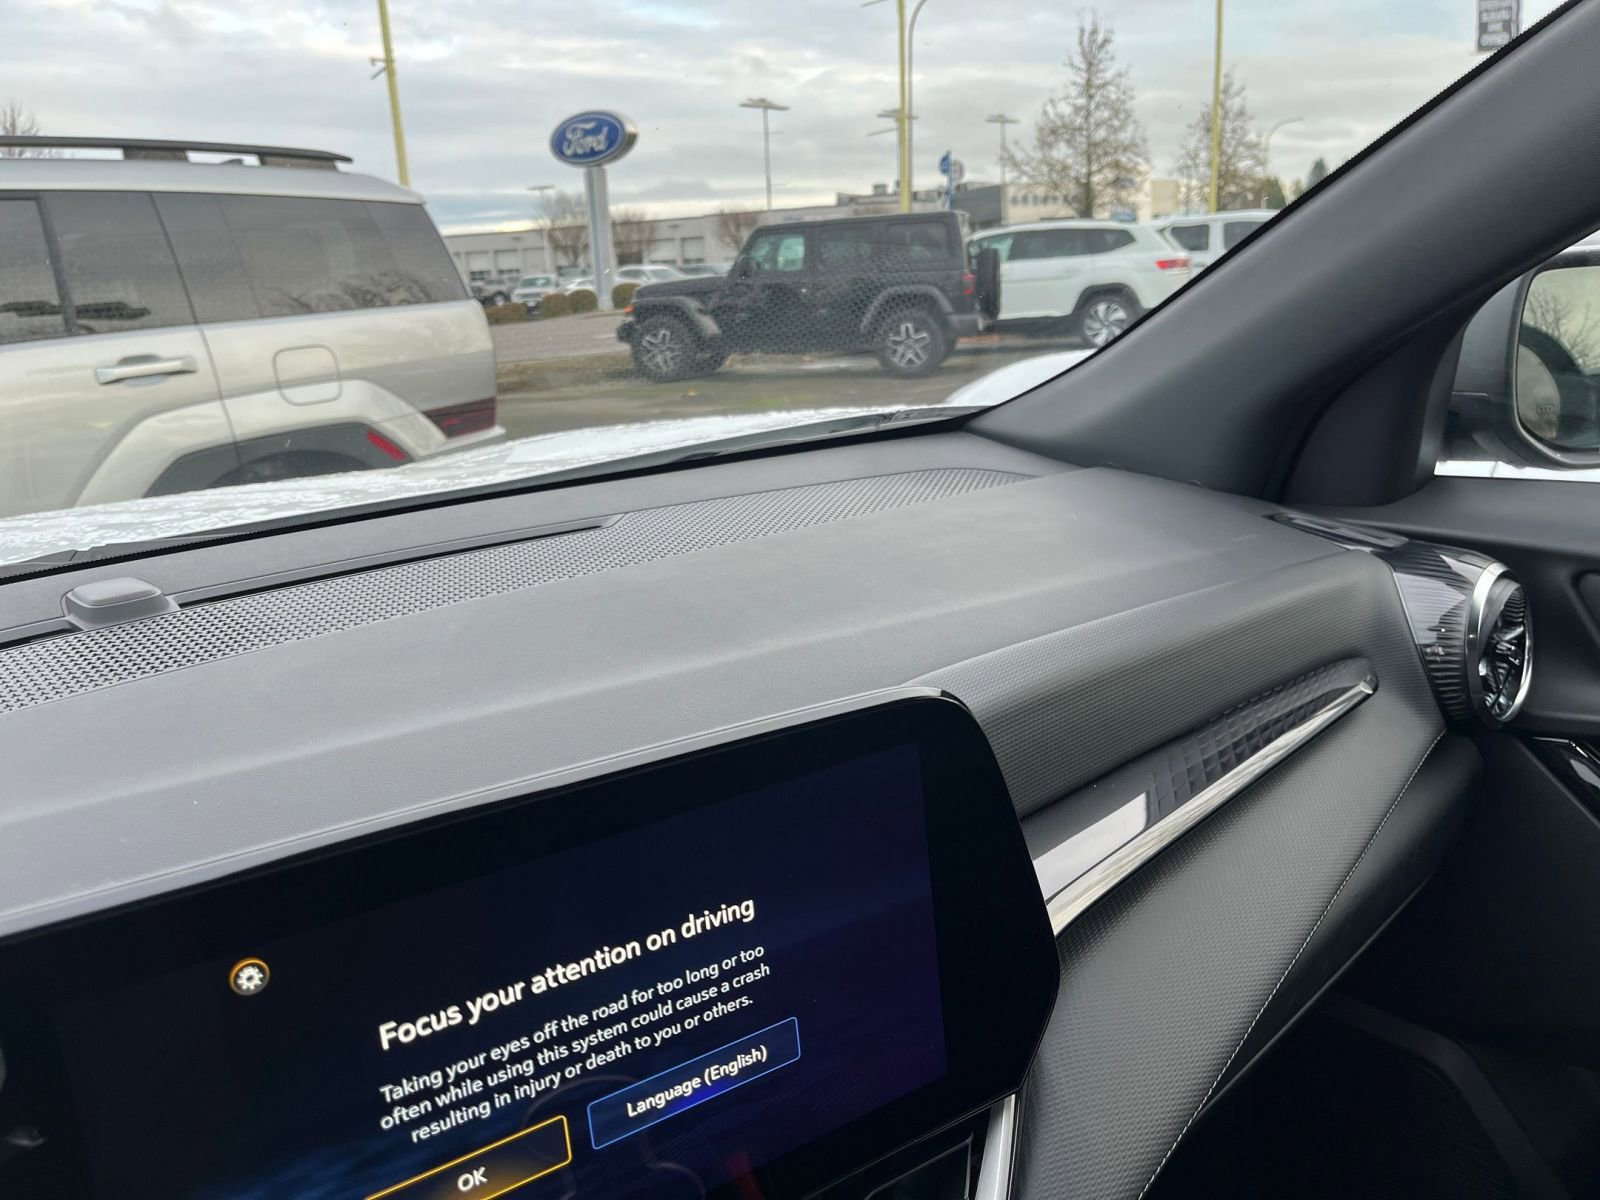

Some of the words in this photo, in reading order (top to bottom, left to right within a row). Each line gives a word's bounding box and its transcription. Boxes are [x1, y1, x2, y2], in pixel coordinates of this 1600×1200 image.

[562, 121, 609, 156] Ford
[379, 1005, 463, 1050] Focus
[466, 981, 526, 1025] your
[531, 941, 641, 994] attention
[646, 928, 676, 951] on
[681, 900, 755, 938] driving
[379, 1070, 443, 1103] Taking
[445, 1052, 487, 1082] your
[490, 1036, 530, 1061] eyes
[533, 1023, 559, 1044] off
[560, 1014, 589, 1032] the
[592, 994, 629, 1021] road
[631, 987, 654, 1006] for
[656, 977, 683, 996] too
[685, 963, 719, 985] long
[722, 955, 737, 970] or
[740, 946, 764, 963] too
[380, 1100, 432, 1129] often
[435, 1079, 484, 1107] while
[487, 1059, 534, 1087] using
[536, 1045, 569, 1066] this
[571, 1021, 628, 1053] system
[631, 1000, 673, 1029] could
[675, 986, 718, 1010] cause
[720, 981, 730, 993] a
[732, 963, 770, 988] crash
[411, 1101, 490, 1143] resulting
[494, 1091, 511, 1108] in
[514, 1071, 561, 1098] injury
[565, 1062, 584, 1079] or
[585, 1041, 632, 1070] death
[634, 1035, 651, 1050] to
[653, 1022, 682, 1046] you
[684, 1014, 700, 1029] or
[703, 995, 754, 1022] others.
[626, 1077, 701, 1117] Language
[704, 1045, 767, 1086] (English)
[457, 1166, 488, 1192] OK
